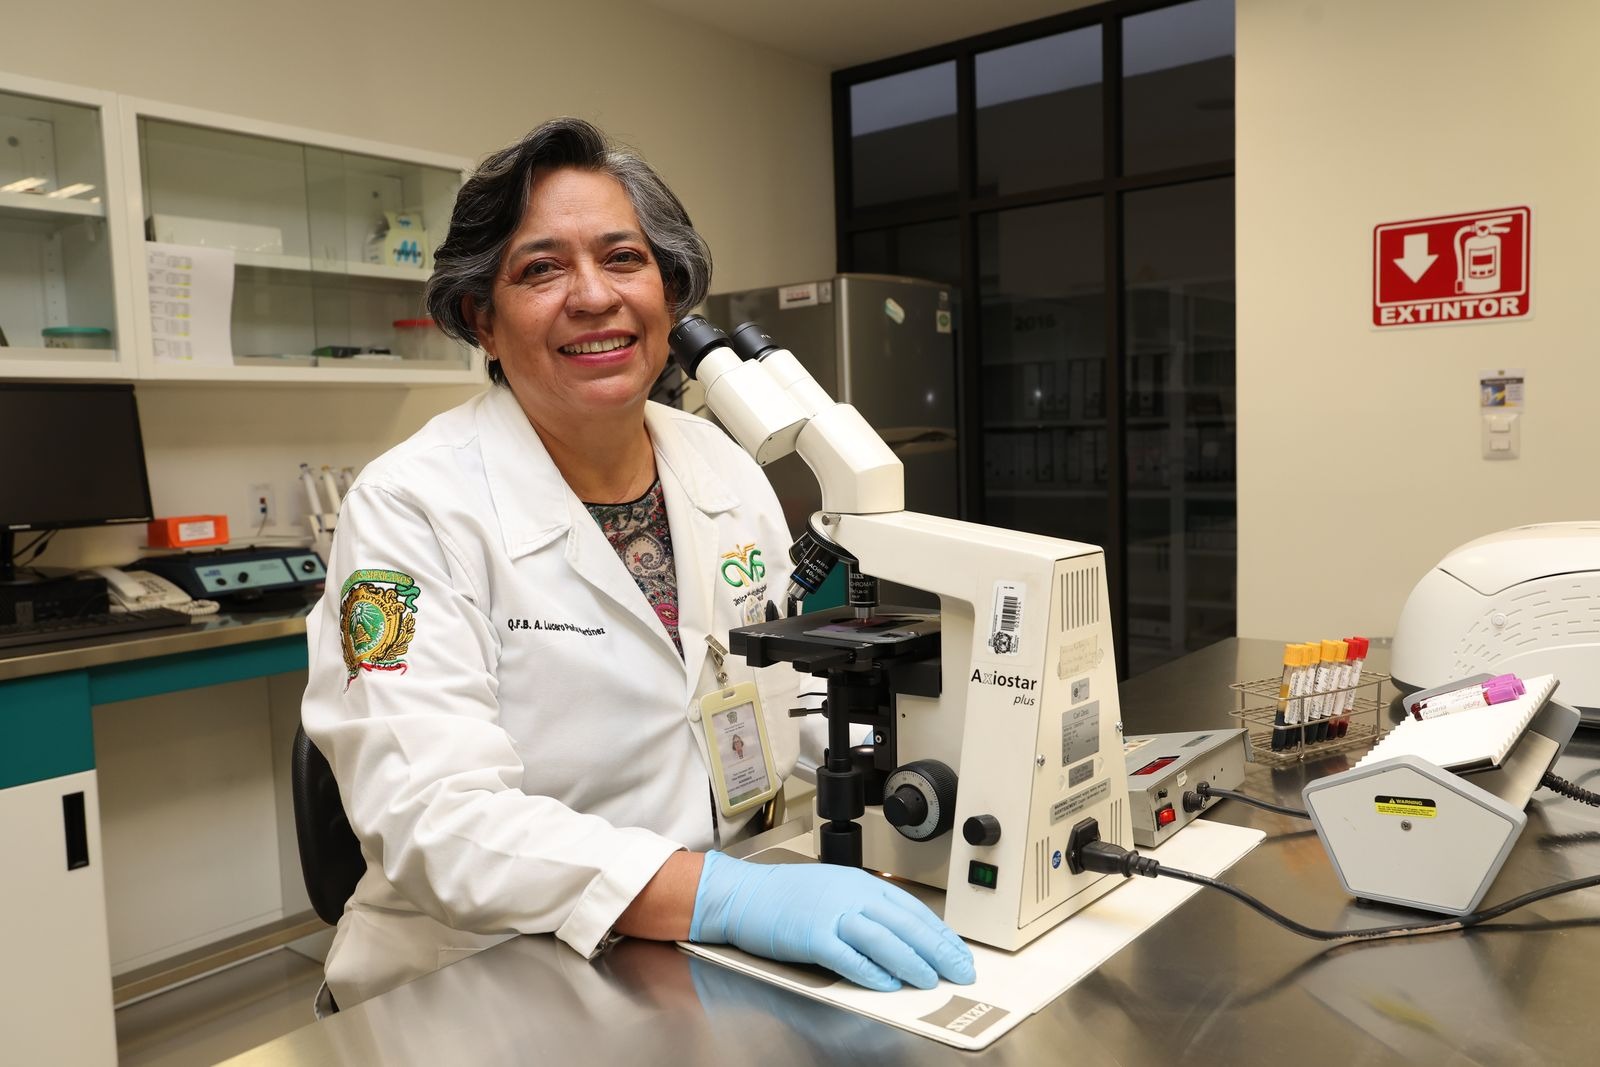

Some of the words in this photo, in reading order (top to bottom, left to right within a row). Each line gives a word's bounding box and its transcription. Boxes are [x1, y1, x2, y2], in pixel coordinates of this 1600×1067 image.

[1380, 297, 1519, 325] EXTINTOR
[508, 619, 531, 631] Q.F.B.
[534, 620, 543, 630] A.
[544, 620, 565, 631] Lucero
[971, 669, 1037, 690] Axiostar
[1013, 694, 1035, 706] plus
